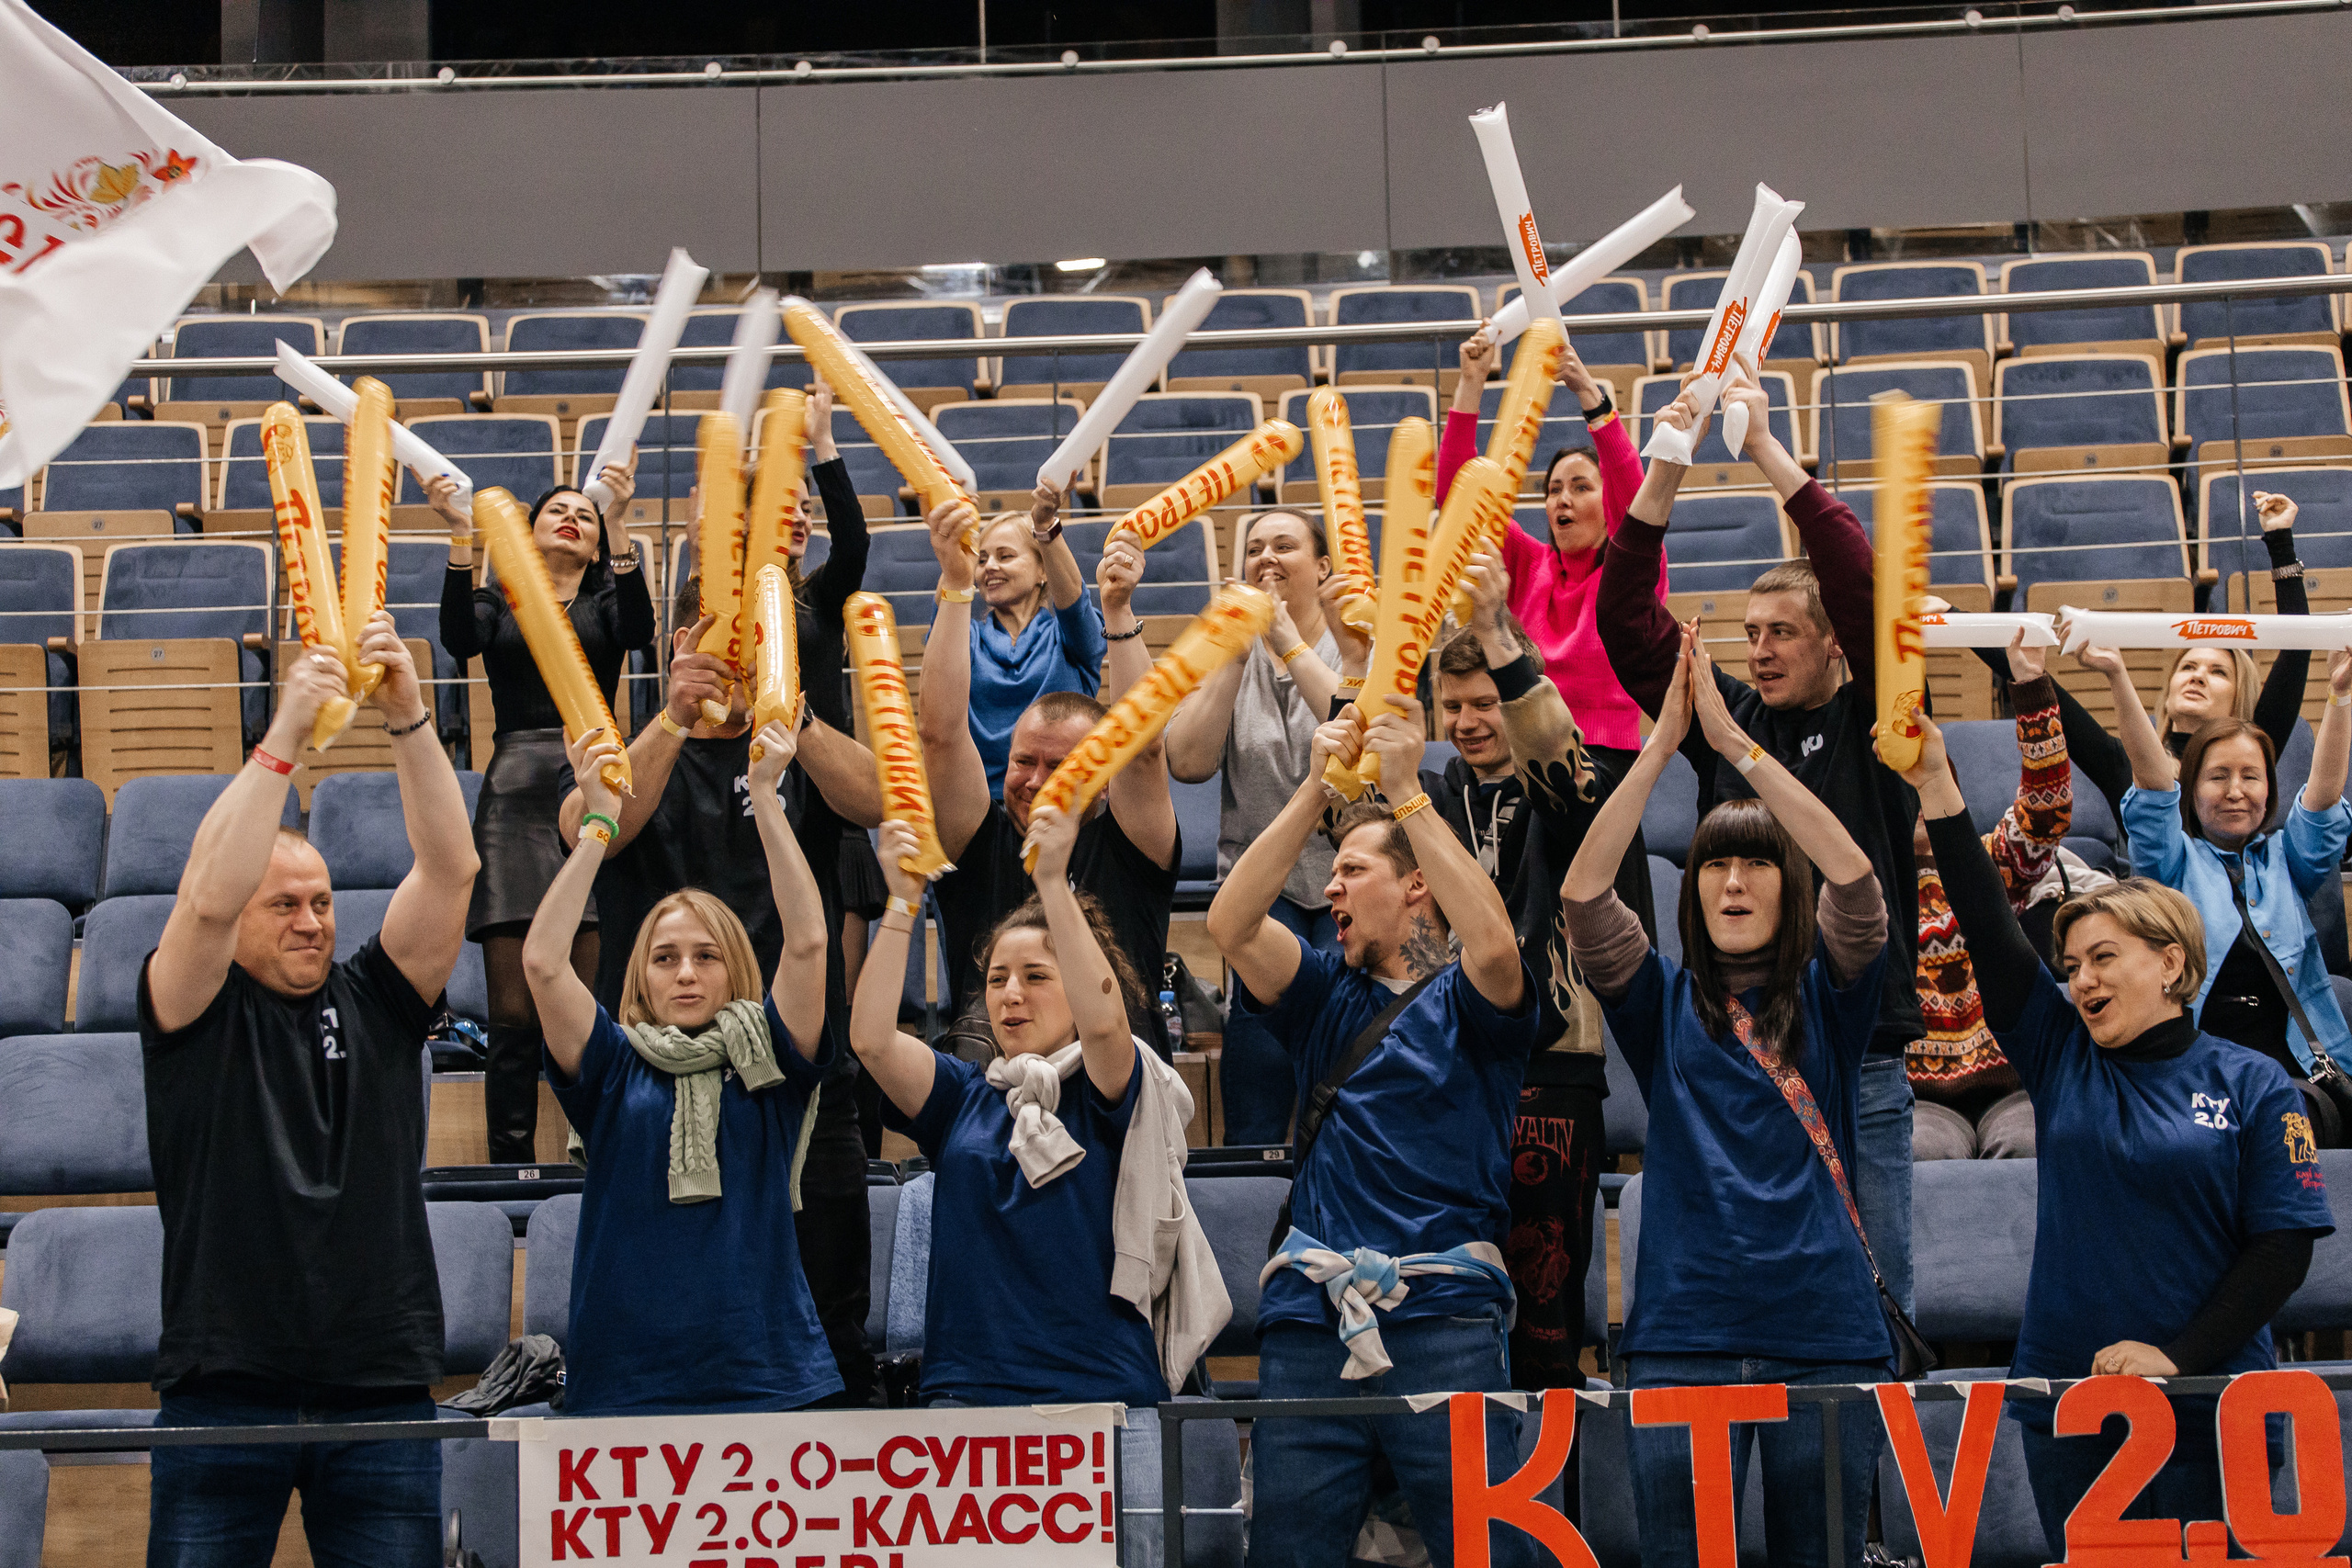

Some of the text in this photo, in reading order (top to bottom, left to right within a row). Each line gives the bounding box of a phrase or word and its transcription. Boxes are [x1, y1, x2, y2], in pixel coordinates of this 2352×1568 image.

[1510, 1115, 1575, 1178] YALTY
[2193, 1111, 2229, 1130] 2.0
[524, 1169, 536, 1179] 26
[1269, 1150, 1280, 1159] 29
[559, 1442, 704, 1503] КТУ
[2053, 1371, 2348, 1564] 2.0
[551, 1502, 681, 1562] КТУ
